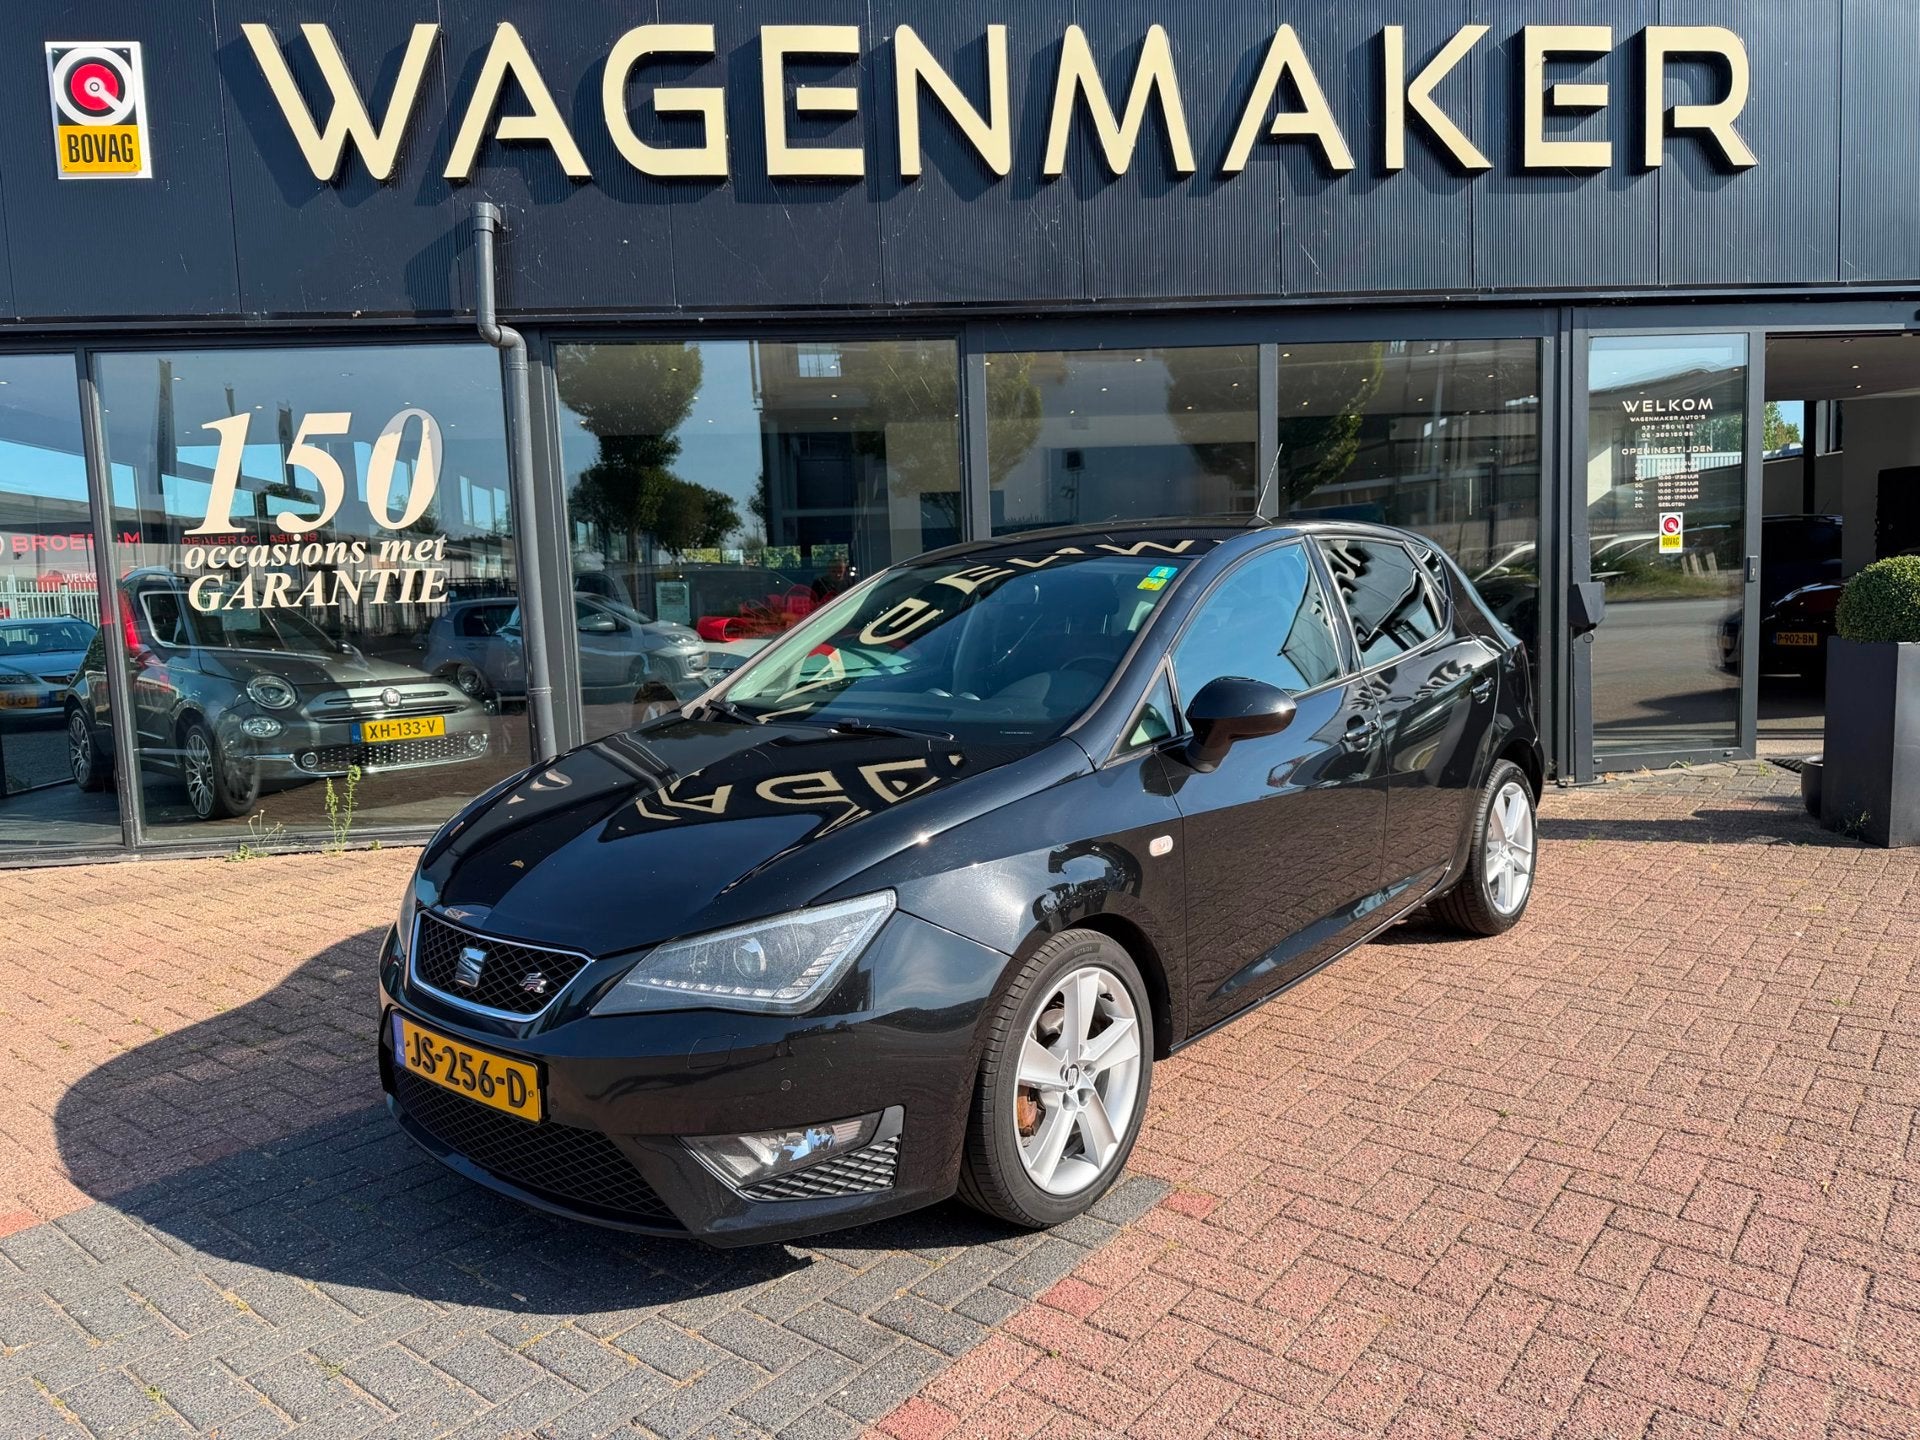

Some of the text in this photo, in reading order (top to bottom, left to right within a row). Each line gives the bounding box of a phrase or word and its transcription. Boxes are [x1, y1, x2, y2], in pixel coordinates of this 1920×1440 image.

[241, 22, 1759, 181] WAGENMAKER
[66, 133, 134, 163] BOVAG
[1622, 398, 1713, 413] WELKOM
[1621, 445, 1713, 455] OPENINGSTIJDEN
[184, 408, 443, 535] 150
[184, 533, 447, 570] occasions met
[188, 568, 451, 612] GARANTIE
[368, 720, 436, 739] XH-133-V
[411, 1032, 527, 1108] JS-256-D
